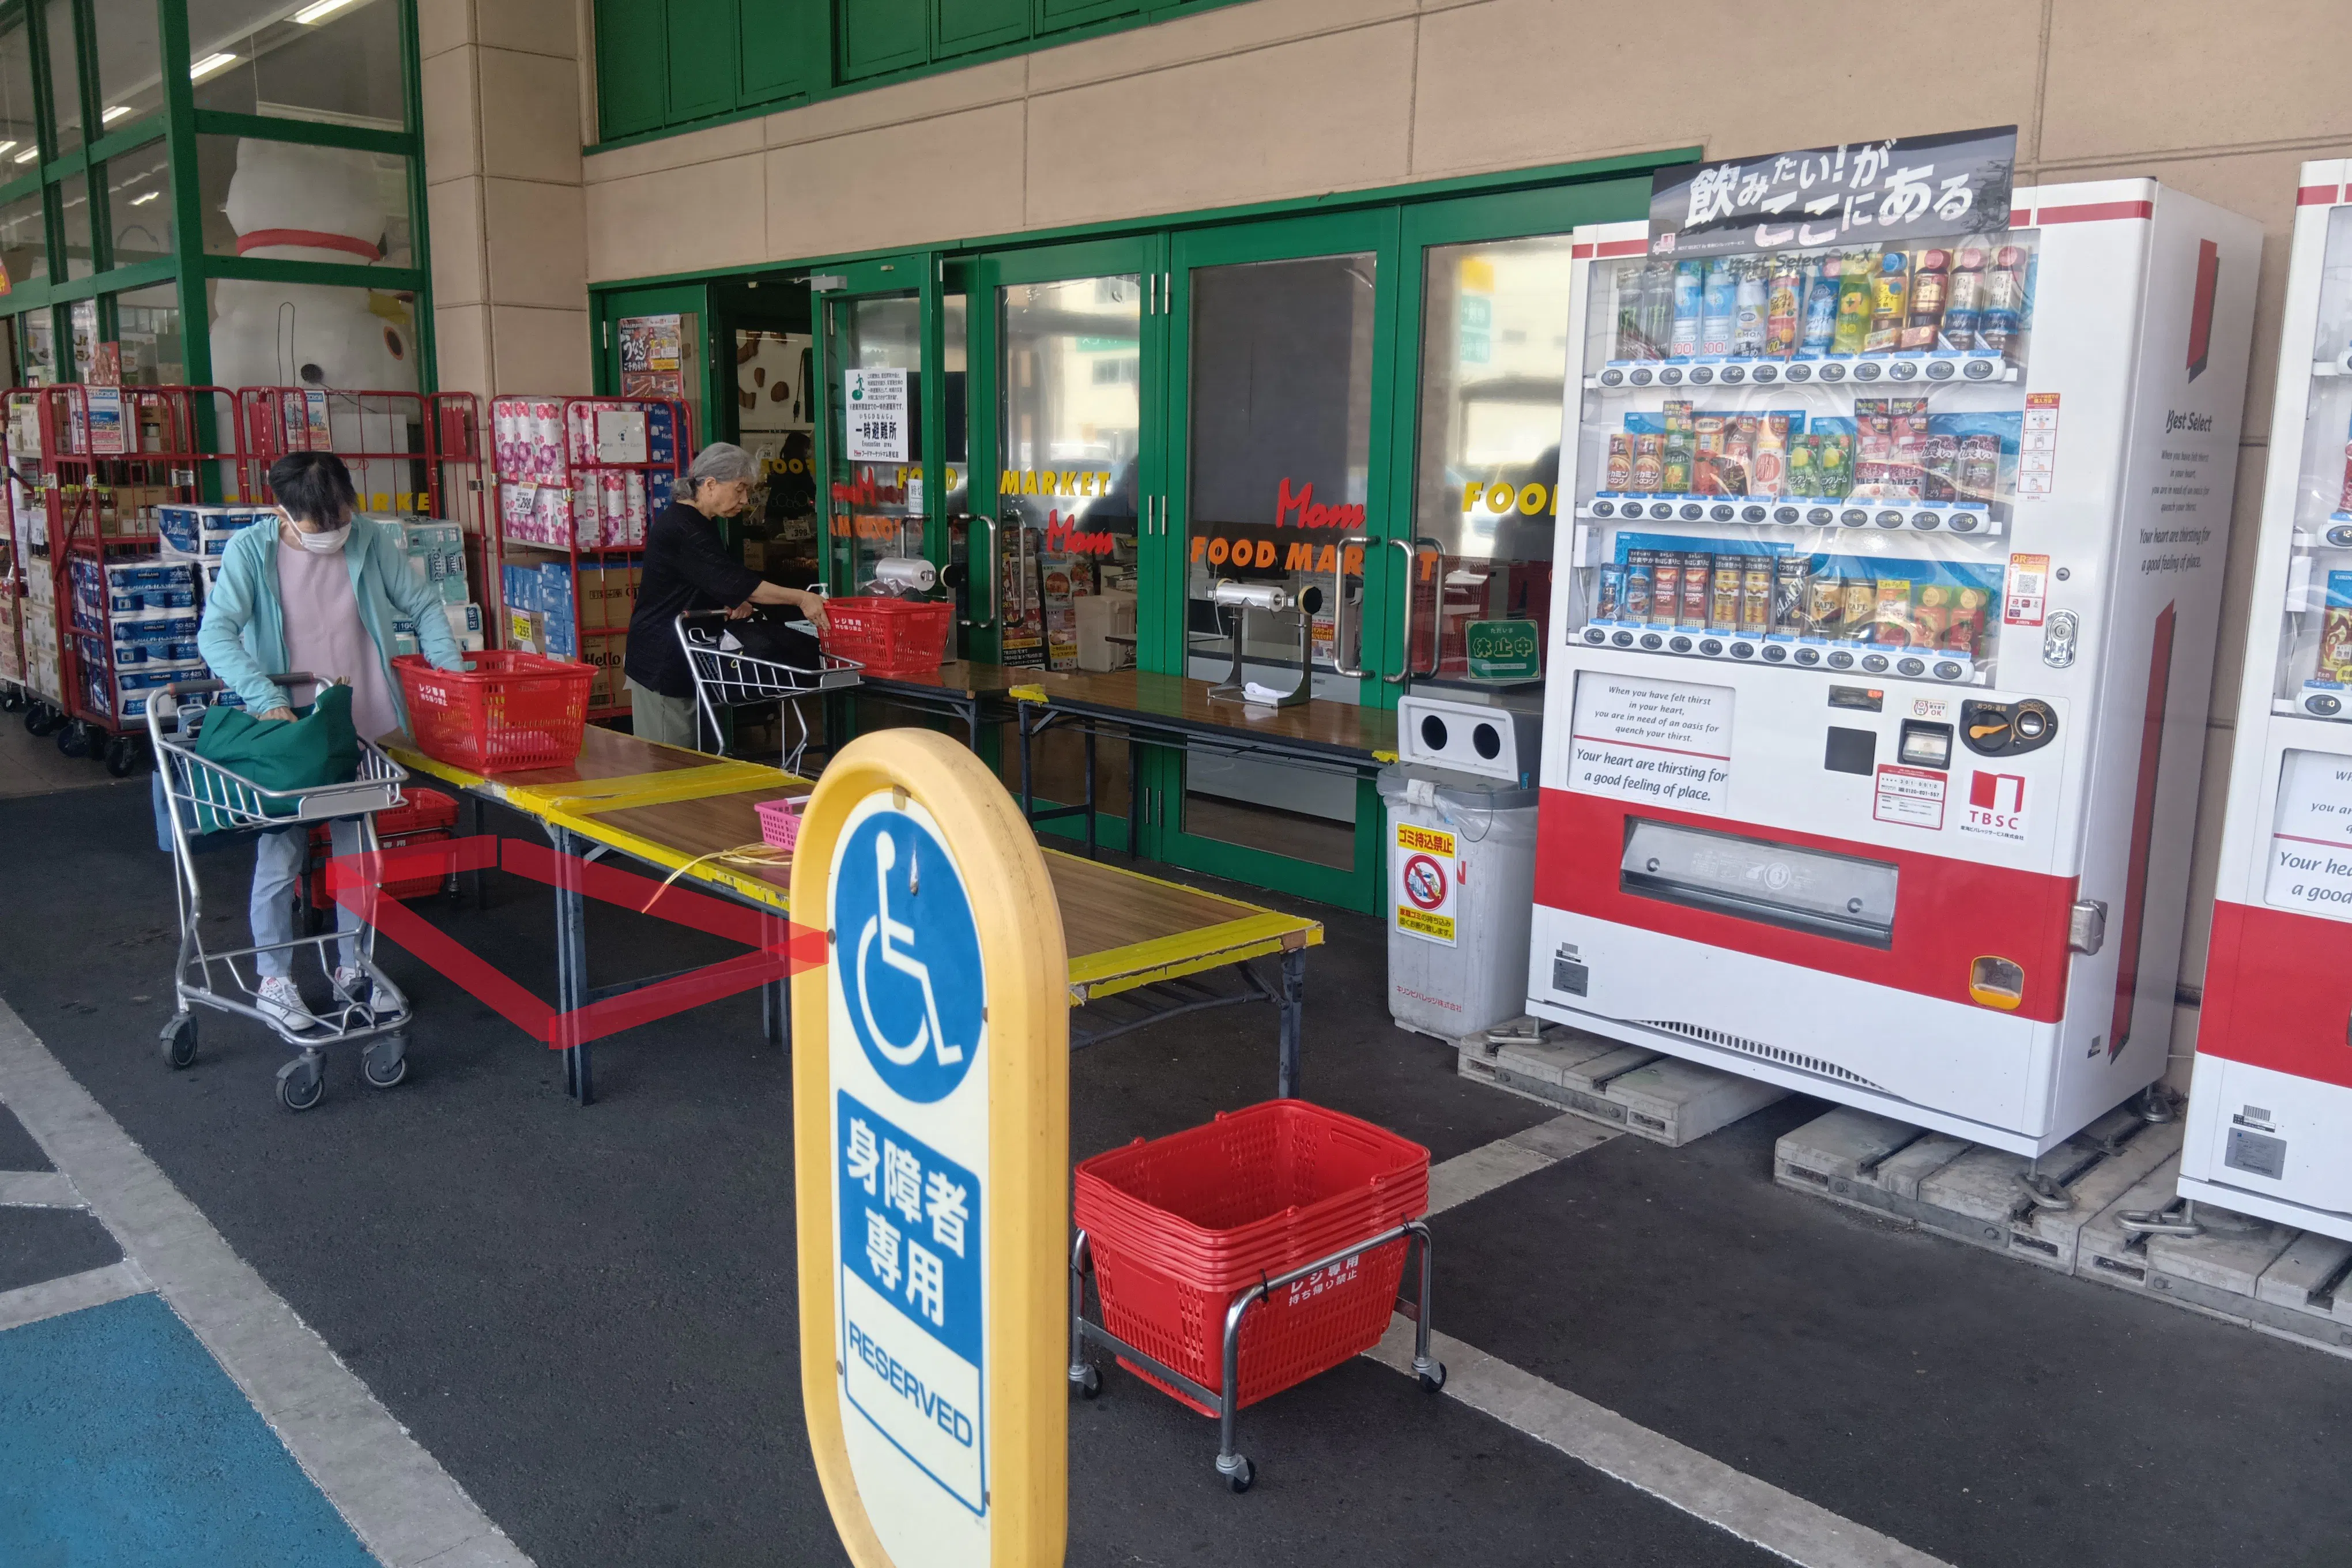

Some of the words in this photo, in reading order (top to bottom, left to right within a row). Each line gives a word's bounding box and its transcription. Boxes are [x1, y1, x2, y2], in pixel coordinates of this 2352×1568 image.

[1754, 164, 1974, 247] ここにある
[855, 421, 897, 440] 一時避難所
[2166, 409, 2187, 434] Best
[2187, 410, 2212, 433] Select
[1000, 470, 1112, 498] MARKET
[1275, 477, 1365, 529] Mom
[1461, 481, 1558, 517] FOO
[1046, 509, 1114, 555] Mom
[2140, 528, 2153, 544] Your
[2154, 527, 2169, 543] heart
[2169, 530, 2178, 543] are
[2179, 526, 2201, 545] thirsting
[2201, 526, 2211, 544] for
[1191, 536, 1278, 568] FOOD
[2146, 555, 2161, 575] good
[2161, 554, 2179, 574] feeling
[834, 617, 862, 626] レジ専用
[585, 652, 621, 666] Hello
[1472, 636, 1533, 658] 休止中
[1608, 685, 1630, 696] When
[1632, 689, 1647, 698] you
[1649, 691, 1669, 700] have
[1670, 693, 1686, 703] felt
[1687, 695, 1712, 706] thirst
[1595, 710, 1609, 718] you
[1626, 713, 1635, 721] in
[1637, 715, 1656, 725] need
[1658, 717, 1669, 726] of
[1682, 722, 1703, 731] oasis
[1705, 723, 1720, 733] for
[1639, 703, 1659, 712] your
[1660, 704, 1685, 716] heart,
[1615, 726, 1644, 736] quench
[1645, 729, 1666, 738] your
[1668, 731, 1693, 742] thirst.
[1577, 748, 1603, 762] Your
[1603, 751, 1633, 768] heart
[1635, 759, 1655, 771] are
[1657, 760, 1707, 781] thirsting
[1708, 768, 1728, 783] for
[1584, 771, 1592, 782] a
[1593, 773, 1622, 787] good
[1622, 776, 1661, 795] feeling
[1663, 784, 1677, 796] of
[1677, 785, 1712, 801] place.
[1969, 810, 2019, 830] TBSC
[2310, 802, 2335, 813] you
[1399, 828, 1453, 855] ゴミ持込禁止
[2280, 851, 2322, 872] Your
[2325, 858, 2352, 877] hea
[2291, 884, 2304, 896] a
[1397, 985, 1462, 1013] キリンビバレッジ株式会社
[846, 1117, 970, 1260] 身障者
[865, 1206, 945, 1328] 専用
[1288, 1269, 1358, 1307] 持ち帰り禁止
[849, 1320, 973, 1449] RESERVED
